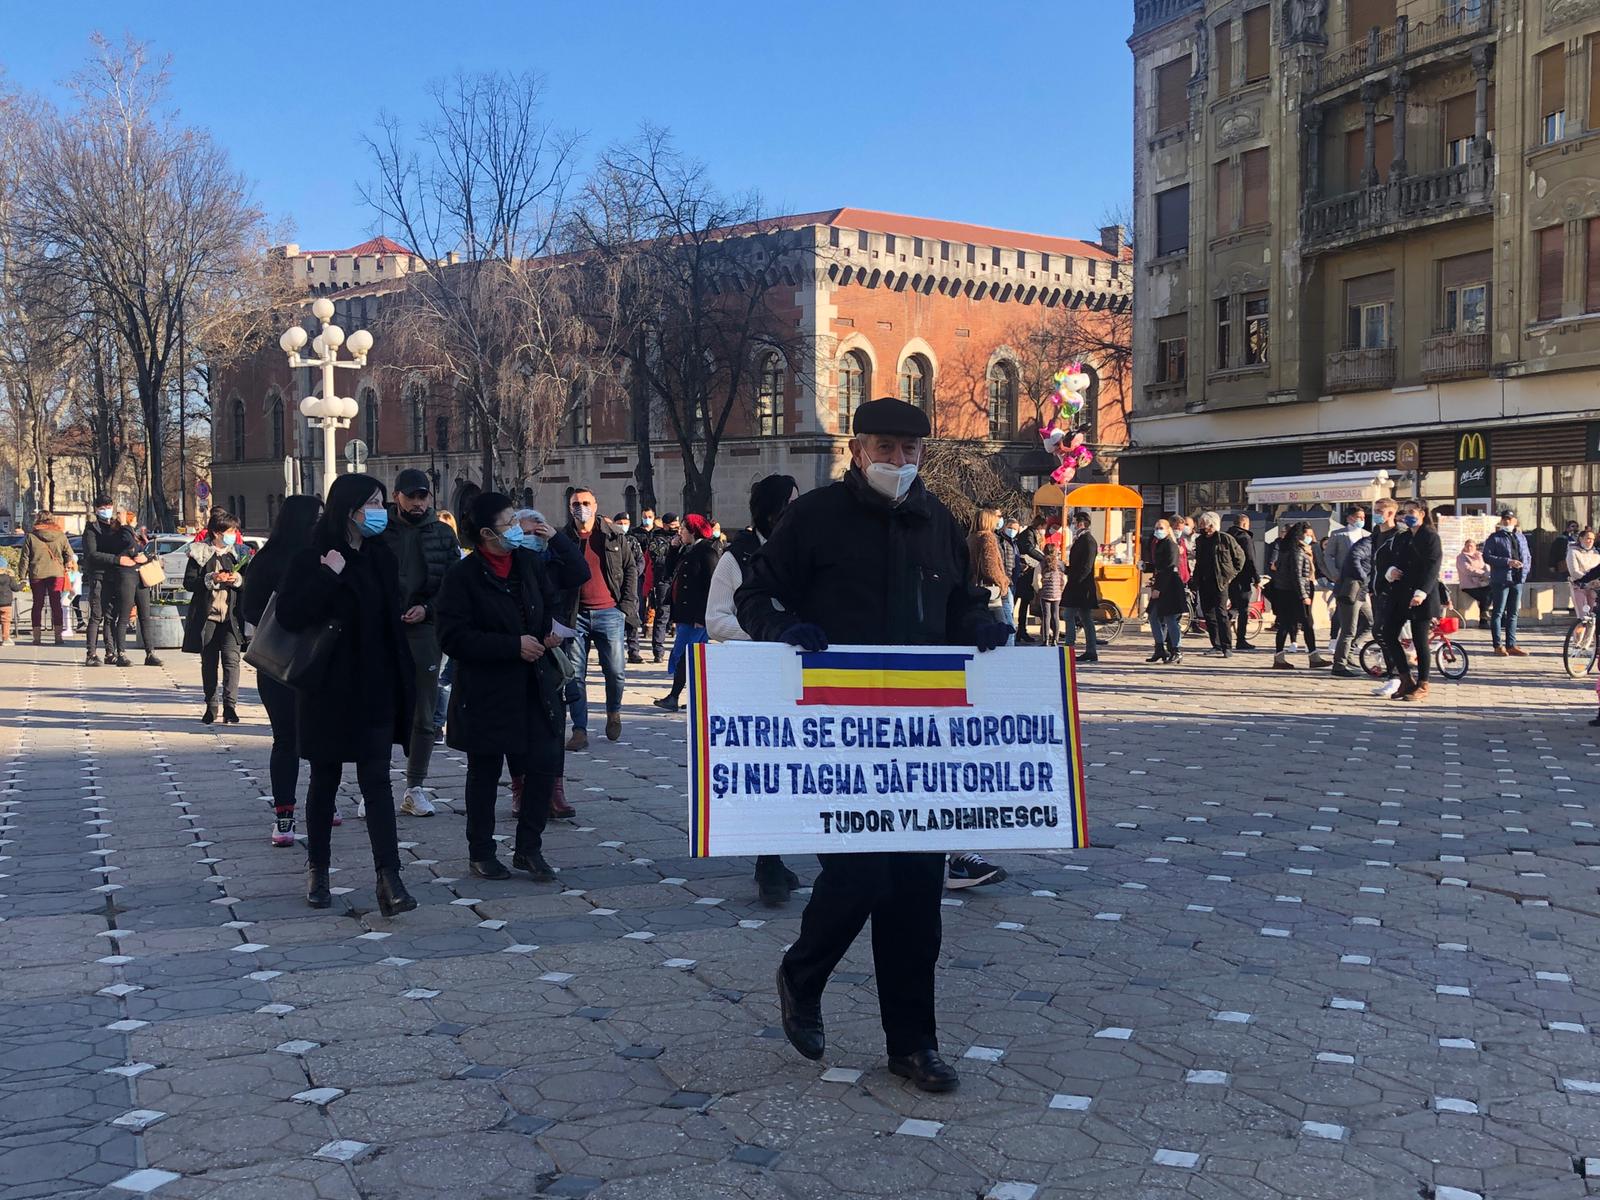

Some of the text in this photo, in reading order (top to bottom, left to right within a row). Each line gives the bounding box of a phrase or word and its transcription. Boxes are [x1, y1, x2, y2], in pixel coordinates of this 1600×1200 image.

[1327, 449, 1396, 466] McExpress
[710, 715, 796, 747] PATRIA
[802, 716, 836, 748] SE
[949, 714, 1063, 748] NORODUL
[744, 763, 780, 795] NU
[786, 763, 868, 795] TAGMA
[819, 805, 1058, 834] TUDOR VLADIMIRESCU
